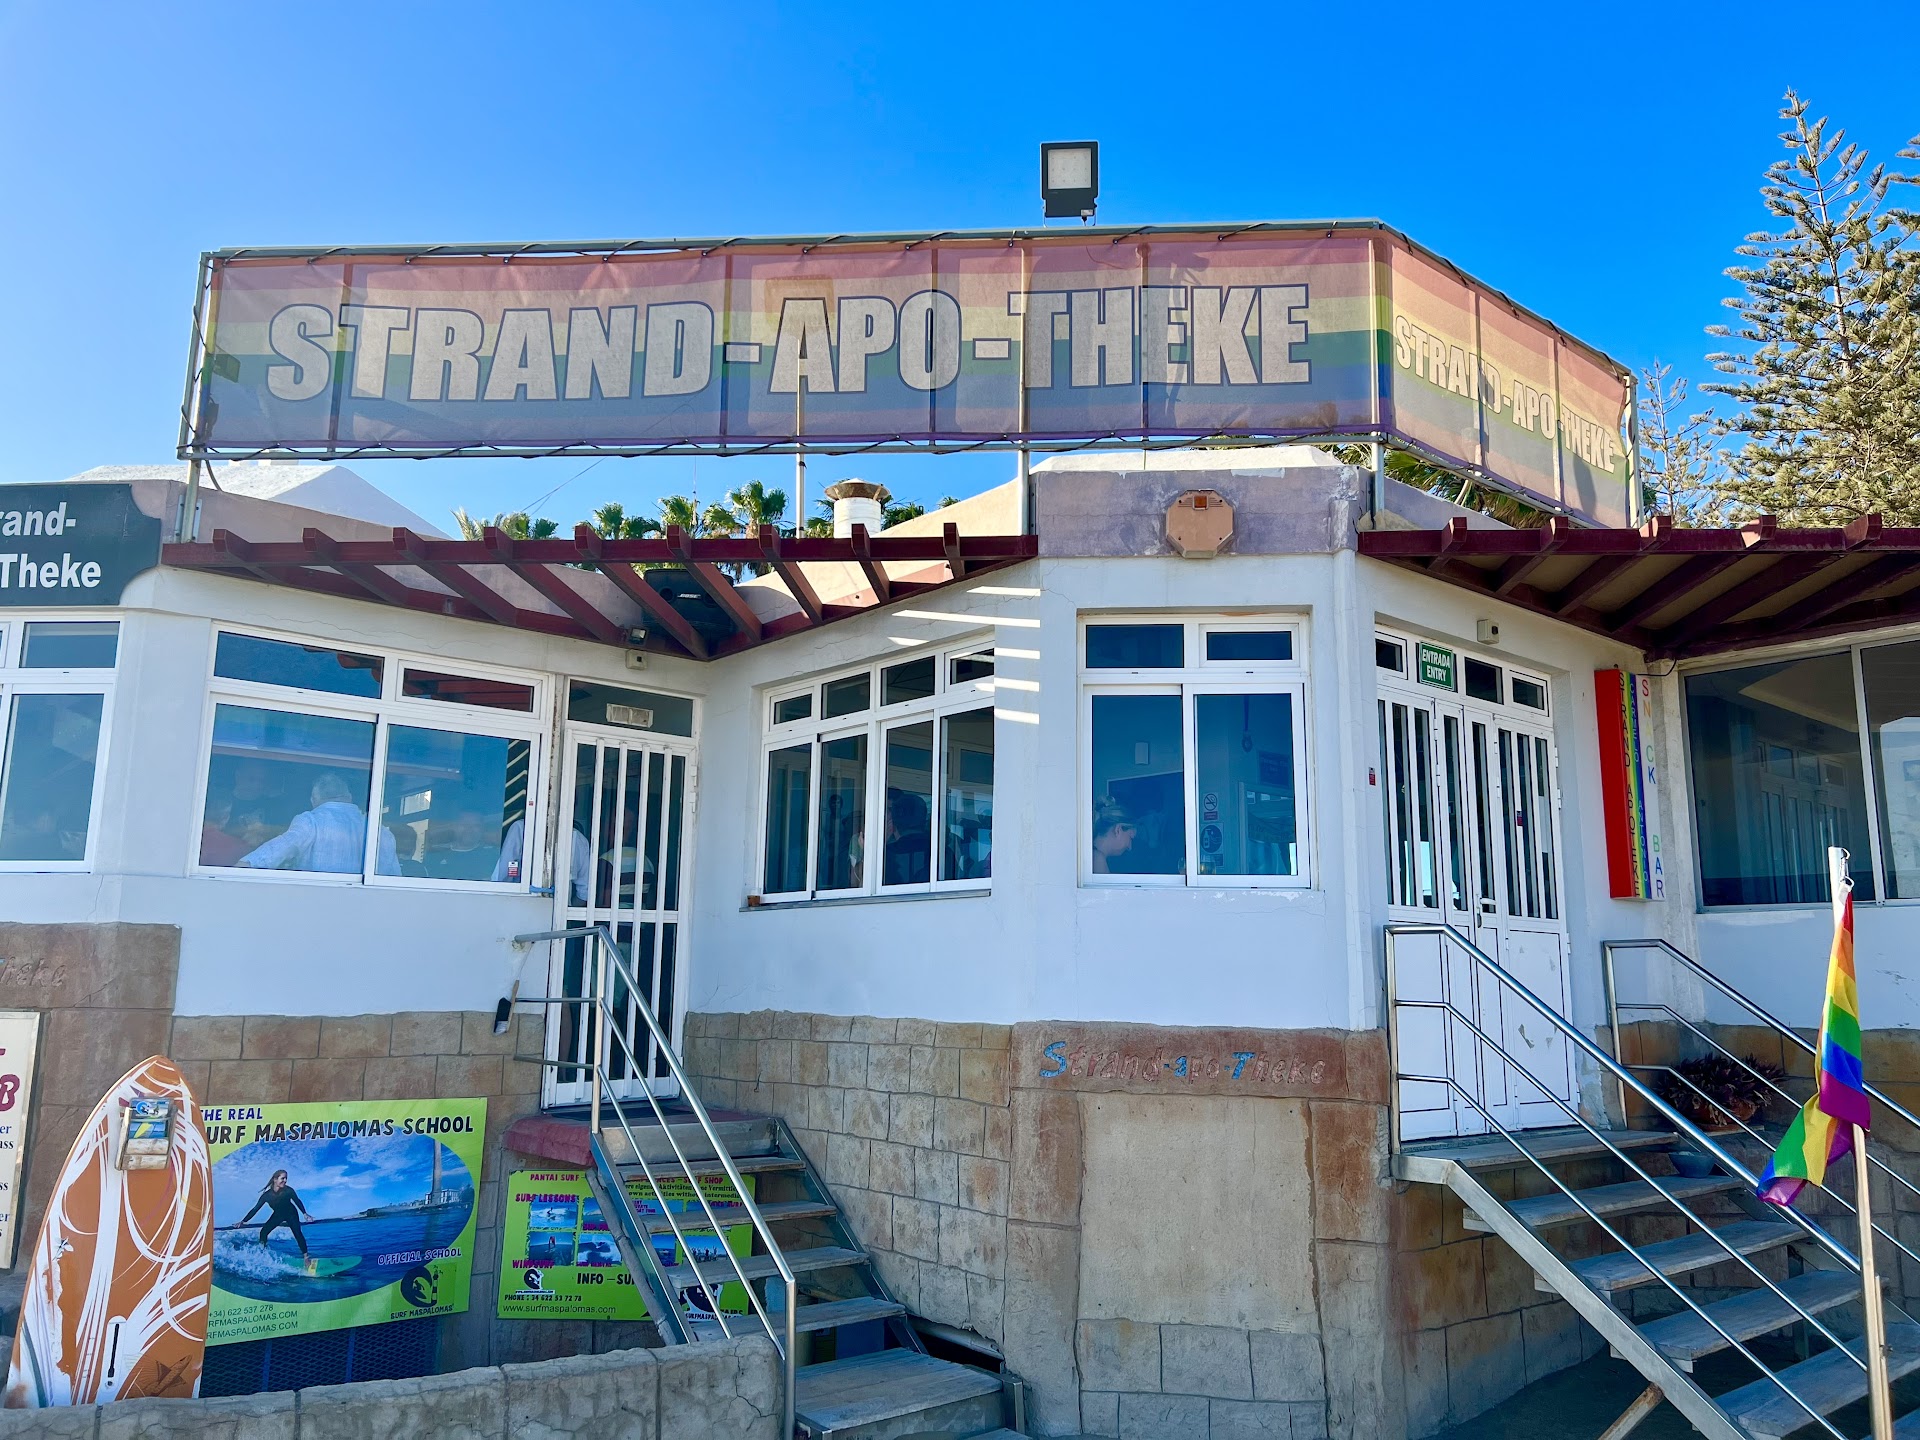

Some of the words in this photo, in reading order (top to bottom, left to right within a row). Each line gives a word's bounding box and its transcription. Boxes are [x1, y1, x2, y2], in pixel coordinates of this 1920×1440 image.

[0, 501, 77, 536] and-
[1422, 648, 1450, 668] ENTRADA
[1426, 665, 1447, 682] ENTRY
[1641, 678, 1657, 786] SNACK
[1652, 833, 1665, 899] BAR
[0, 956, 67, 987] heke
[228, 1107, 263, 1120] REAL
[206, 1125, 246, 1144] URF
[254, 1118, 394, 1142] MASPALOMAS
[402, 1115, 474, 1135] SCHOOL
[530, 1173, 558, 1181] PANTAI
[560, 1173, 580, 1181] SURF
[705, 1176, 724, 1184] SHOP
[378, 1251, 421, 1265] OFFICIAL
[424, 1247, 462, 1260] SCHOOL
[577, 1272, 604, 1285] INFO
[208, 1309, 226, 1319] +34)
[227, 1308, 242, 1317] 622
[243, 1306, 258, 1315] 537
[259, 1304, 274, 1312] 278
[391, 1310, 408, 1319] SURF
[409, 1304, 454, 1317] MASPALOMAS
[502, 1303, 616, 1315] www.surfmaspalomas.com
[208, 1310, 298, 1328] RFMASPALOMAS.COM
[206, 1321, 299, 1340] RFMASPALOMAS.COM
